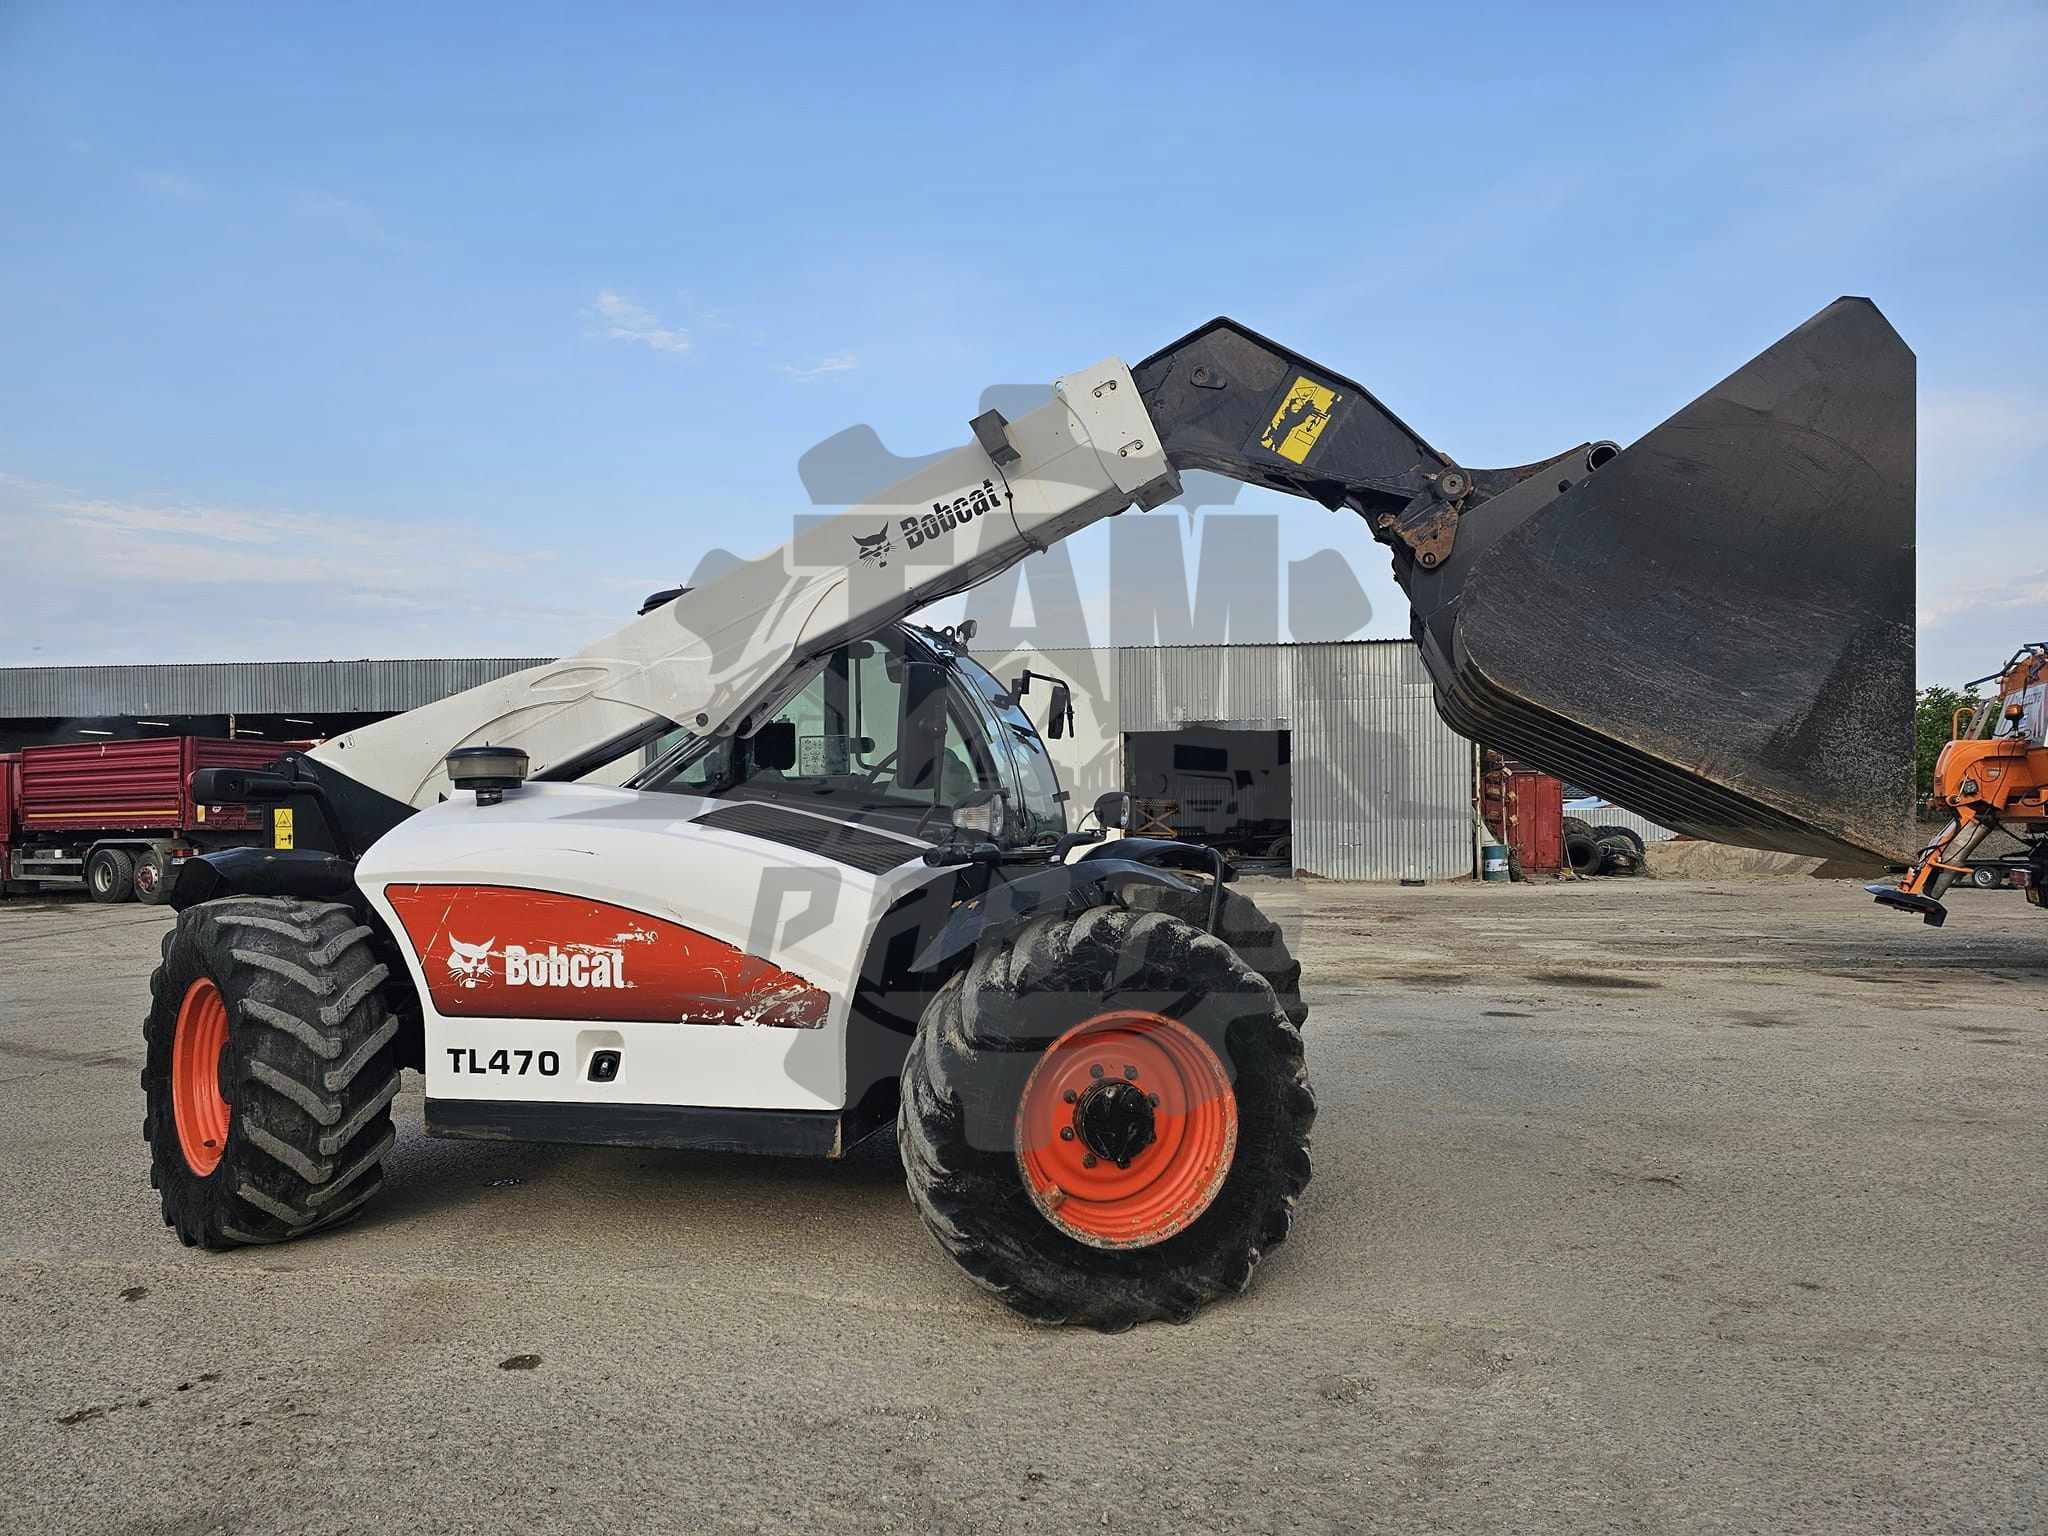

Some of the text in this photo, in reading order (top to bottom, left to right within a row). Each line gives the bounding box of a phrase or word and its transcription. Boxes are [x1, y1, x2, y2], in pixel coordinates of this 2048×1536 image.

[900, 478, 1001, 550] Bobcat
[505, 945, 625, 988] Bobcat
[447, 1048, 560, 1076] TL470
